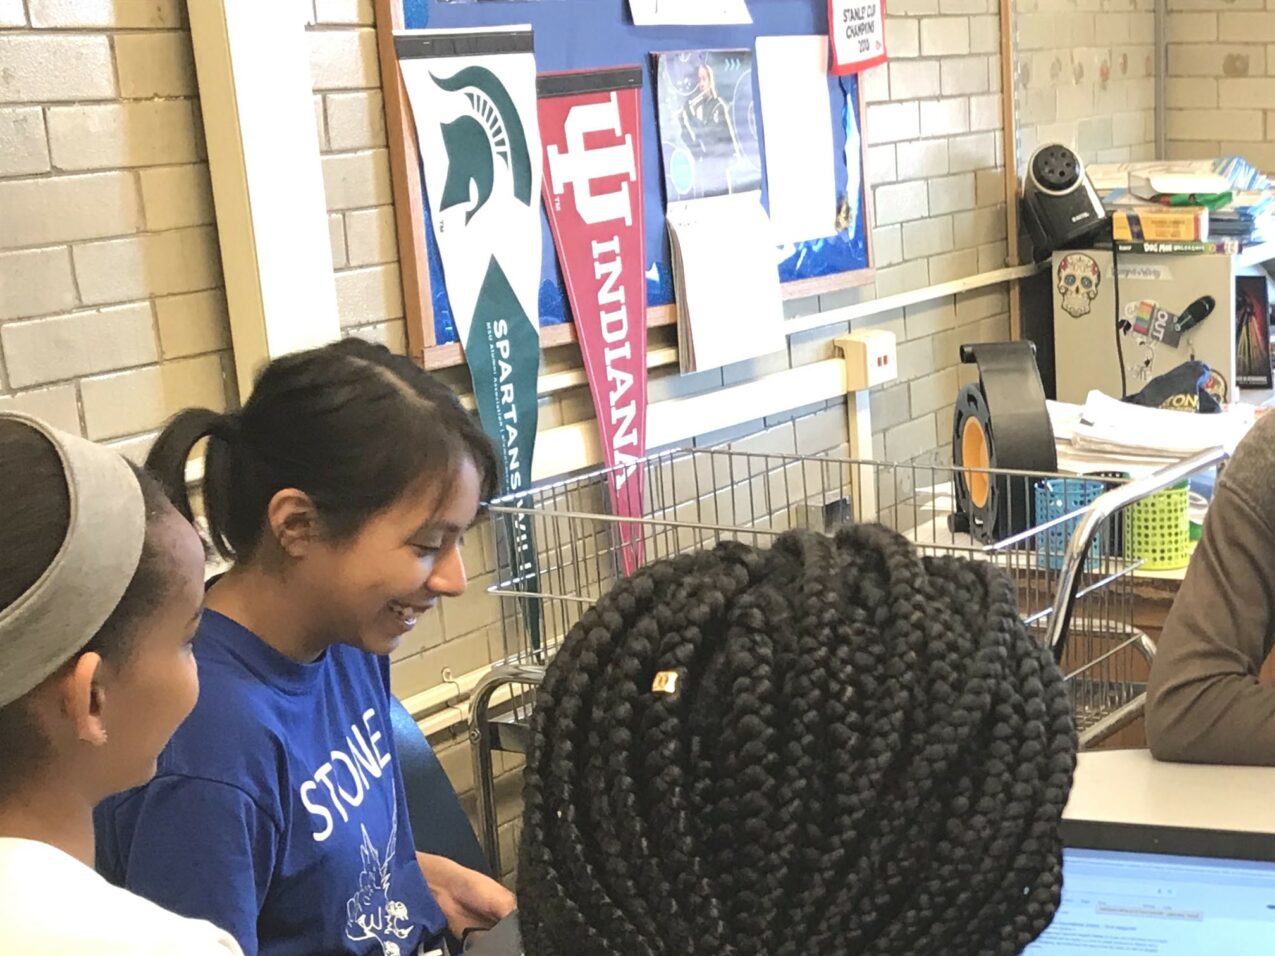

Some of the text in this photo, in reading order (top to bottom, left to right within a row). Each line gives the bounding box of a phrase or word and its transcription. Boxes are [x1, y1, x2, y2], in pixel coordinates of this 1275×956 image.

[591, 235, 640, 490] INDIANA
[1151, 311, 1168, 341] OUT
[493, 319, 521, 491] SPARTANS
[300, 708, 391, 841] STONE
